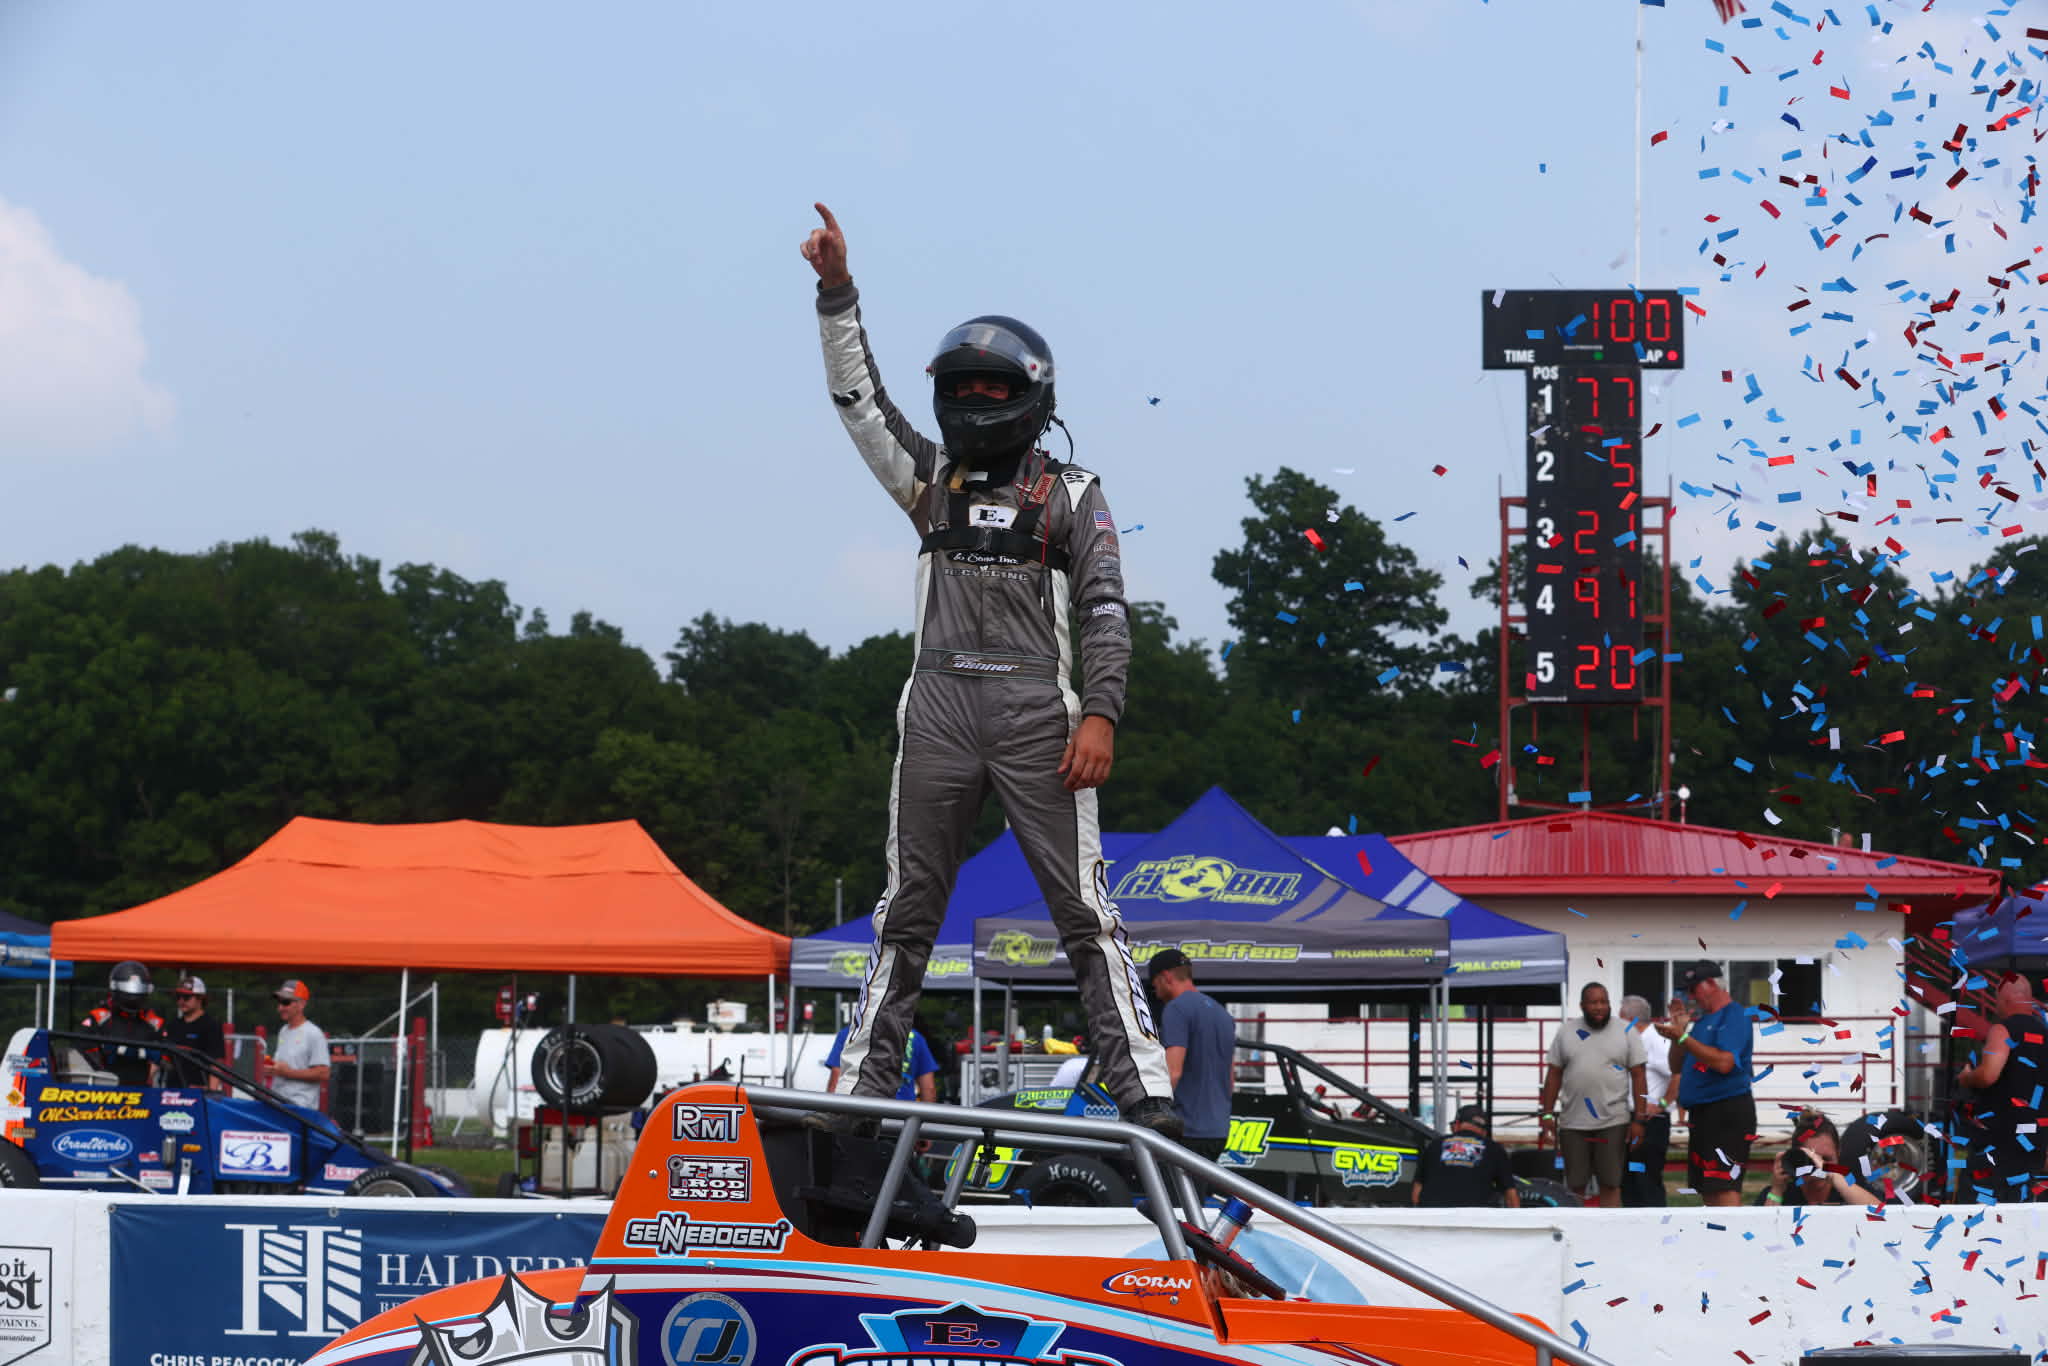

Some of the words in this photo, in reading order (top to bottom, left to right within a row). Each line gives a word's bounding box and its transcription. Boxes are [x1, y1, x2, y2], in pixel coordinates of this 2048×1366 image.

[1593, 299, 1671, 342] 100
[1504, 350, 1535, 363] TIME
[1533, 366, 1559, 380] POS
[1538, 385, 1553, 414] 1
[1576, 377, 1635, 417] 77
[1536, 452, 1555, 481] 2
[1610, 444, 1635, 487] 5
[977, 508, 1006, 523] E.
[1536, 518, 1555, 548] 3
[1575, 511, 1636, 554] 21
[1536, 585, 1555, 615] 4
[1575, 577, 1636, 618] 91
[1536, 652, 1555, 683] 5
[1575, 645, 1636, 689] 20
[1180, 943, 1300, 961] Steffens
[39, 1087, 144, 1105] BROWN'S
[1335, 1150, 1399, 1172] GWS
[688, 1178, 745, 1189] ROD
[1049, 1162, 1108, 1193] Hoosier
[671, 1188, 745, 1199] ENDS
[13, 1258, 27, 1278] it
[1123, 1275, 1192, 1289] DORAN
[150, 1352, 204, 1366] CHRIS
